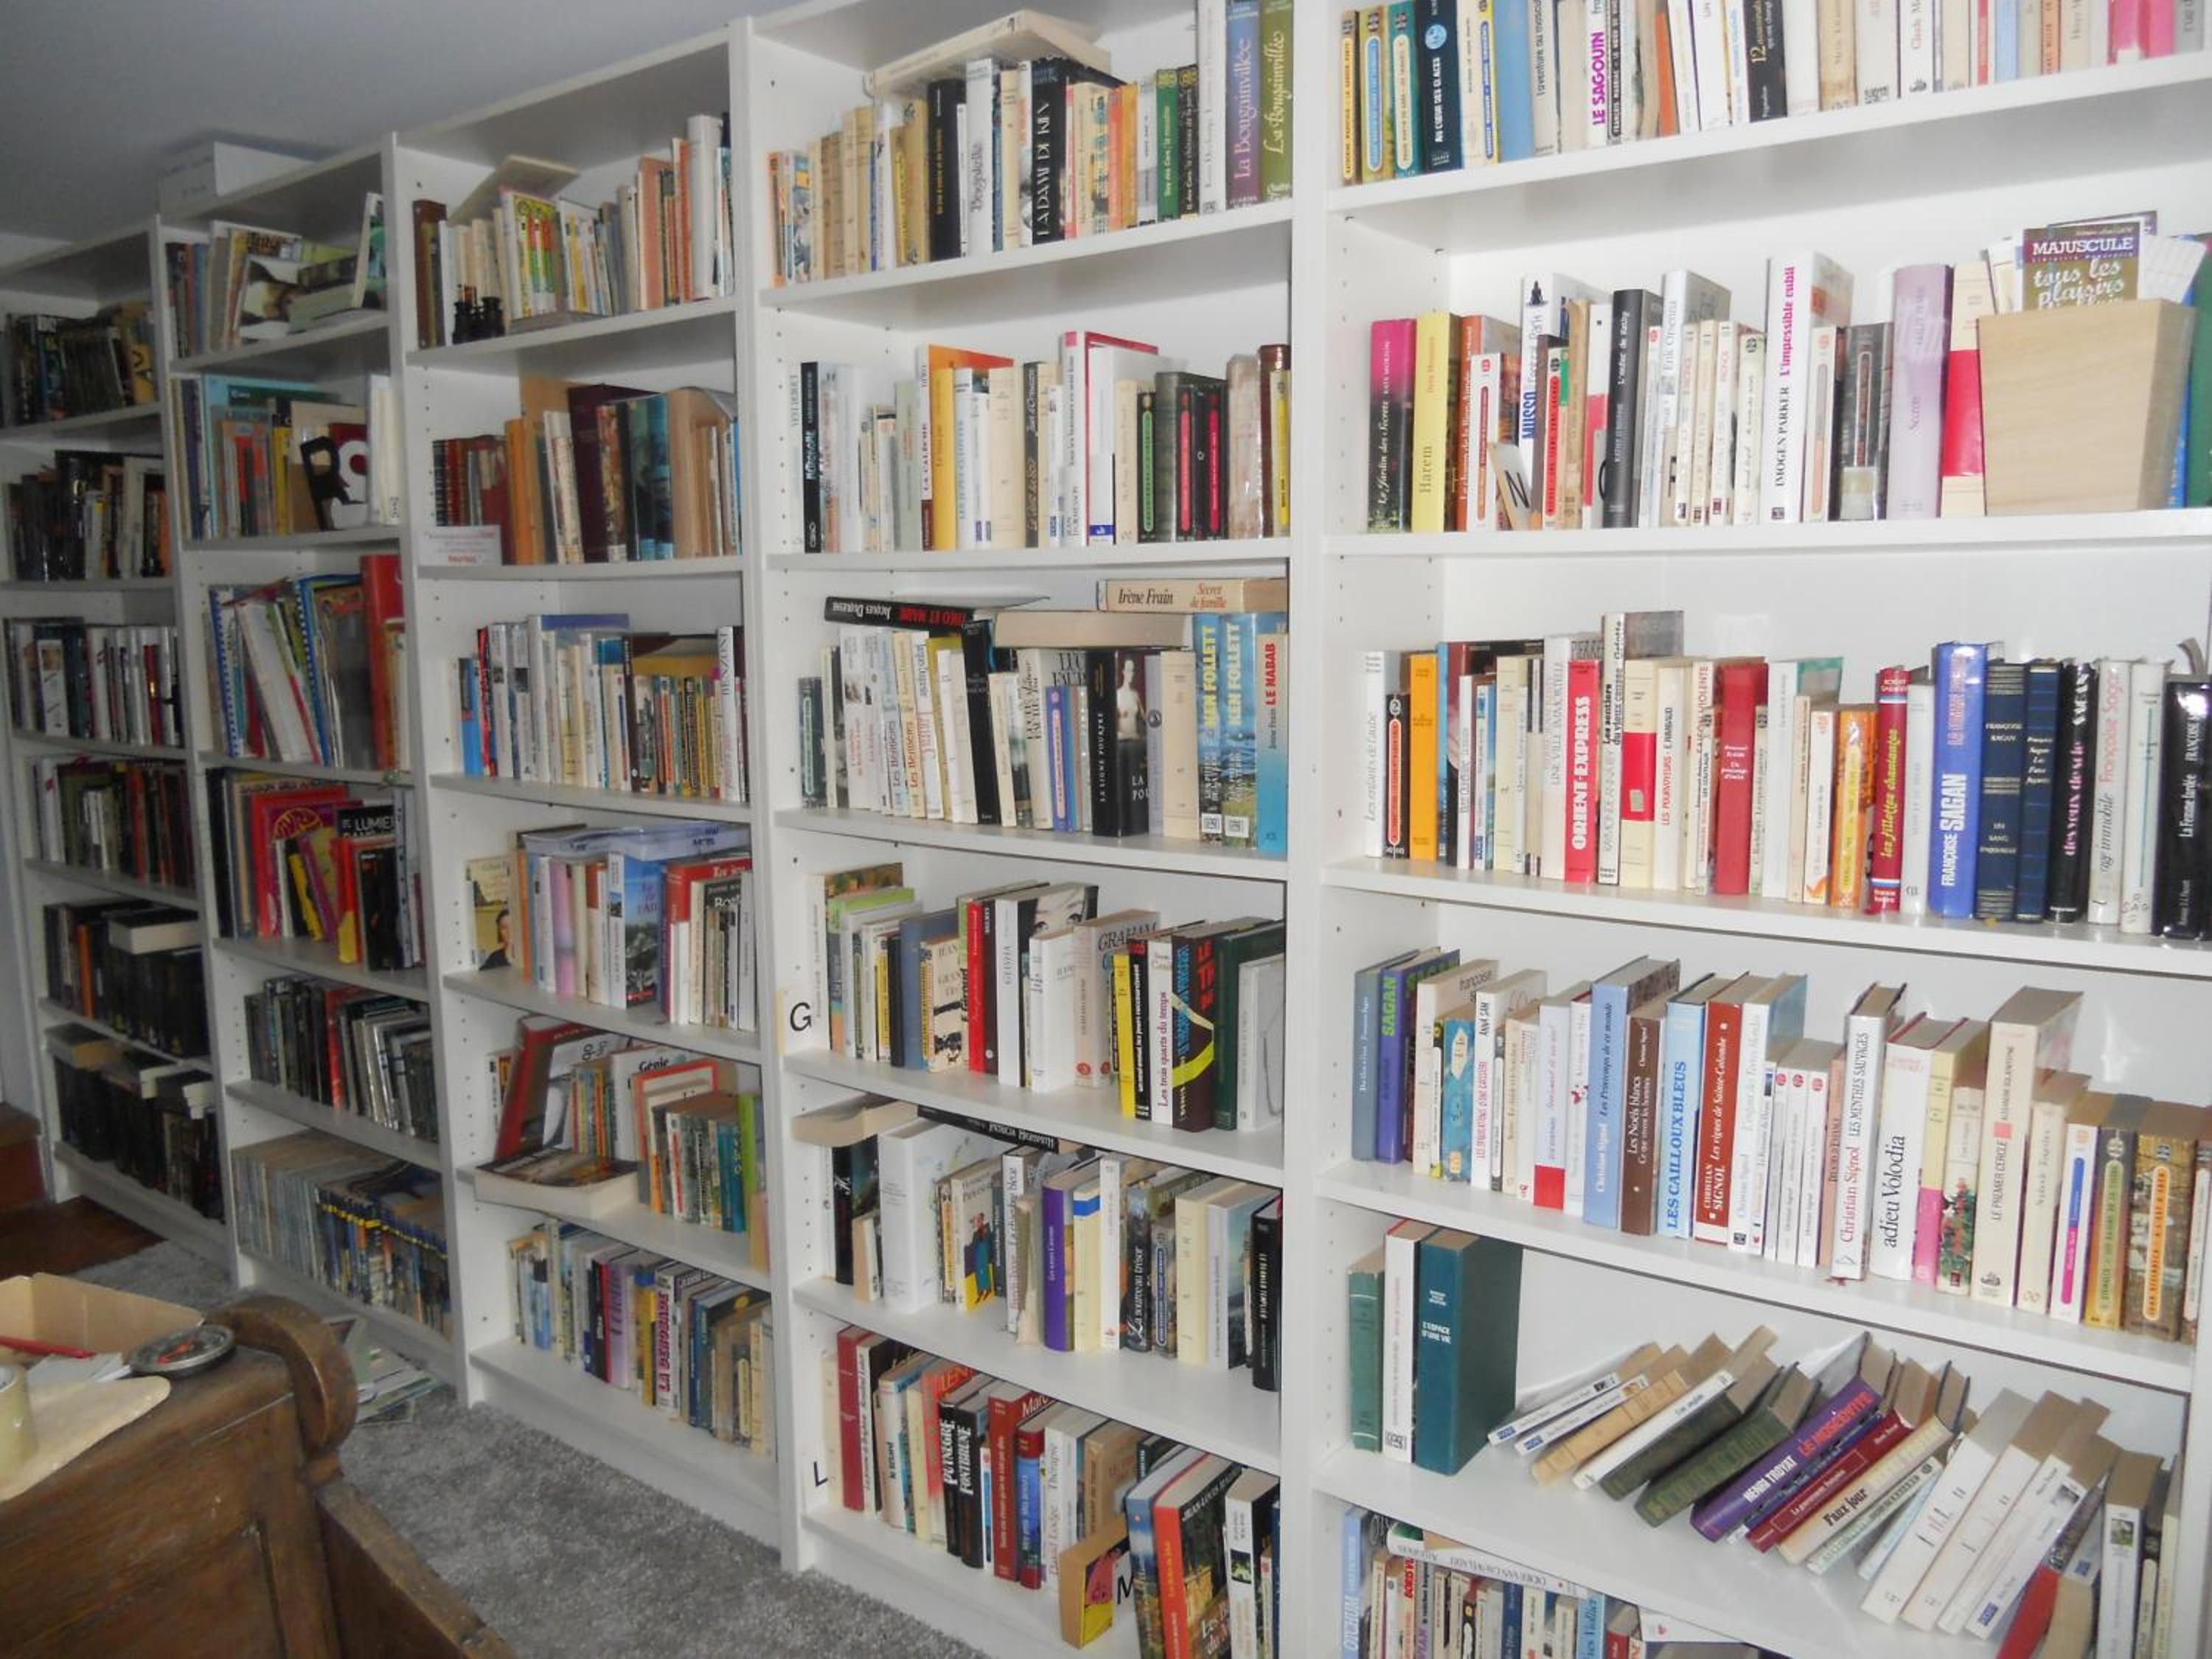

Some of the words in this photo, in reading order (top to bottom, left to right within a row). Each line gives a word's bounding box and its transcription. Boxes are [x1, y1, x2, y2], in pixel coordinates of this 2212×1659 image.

[1591, 32, 1606, 105] SAGOUIN
[1233, 37, 1257, 154] Bougainvillée
[1592, 109, 1606, 125] LE
[1264, 128, 1284, 154] La
[1234, 159, 1250, 178] La
[2032, 237, 2134, 256] MAJUSCULE
[1778, 302, 1793, 378] L'impossible
[1778, 386, 1790, 435] PARKER
[1378, 439, 1389, 454] des
[1774, 437, 1787, 487] IMOGEN
[1419, 445, 1433, 495] Harem
[1118, 588, 1145, 605] Irène
[1147, 588, 1174, 605] Frain
[1203, 625, 1217, 692] FOLLETT
[1226, 622, 1242, 690] FOLLETT
[1265, 643, 1276, 688] NABAB
[1203, 694, 1217, 728] KEN
[1227, 692, 1242, 727] KEN
[1265, 689, 1276, 706] LE
[1571, 697, 1590, 850] ORIENT-EXPRESS
[1940, 773, 1966, 831] SAGAN
[1941, 832, 1958, 887] FRANÇOISE
[789, 1001, 812, 1032] G
[1157, 991, 1170, 1020] temps
[1381, 977, 1396, 1037] SAGAN
[1478, 1001, 1490, 1018] SAM
[1157, 1021, 1168, 1035] du
[1478, 1018, 1489, 1037] ANNA
[1158, 1036, 1170, 1065] quarts
[1854, 1032, 1868, 1076] SAUVAGES
[1157, 1067, 1168, 1086] trois
[1628, 1075, 1641, 1106] blancs
[1672, 1060, 1686, 1112] BLEUS
[1157, 1088, 1169, 1107] Les
[1599, 1102, 1610, 1118] Les
[1848, 1077, 1865, 1121] MENTHES
[1627, 1137, 1638, 1155] Les
[1847, 1121, 1861, 1138] LES
[1595, 1152, 1607, 1193] Christian
[1666, 1116, 1683, 1197] CAILLOUX
[1843, 1146, 1861, 1185] Signol
[1880, 1135, 1905, 1198] Volodia
[1994, 1140, 2008, 1172] CERCLE
[1712, 1164, 1725, 1211] SIGNOL
[1992, 1173, 2006, 1208] PREMIER
[1665, 1197, 1679, 1229] LES
[1839, 1186, 1857, 1243] Christian
[1879, 1200, 1902, 1248] adieu
[1992, 1208, 2003, 1221] LE
[1742, 1478, 1772, 1503] HENRI
[1766, 1455, 1798, 1484] TROYAT
[1823, 1506, 1851, 1528] Faux
[1847, 1487, 1870, 1512] jour
